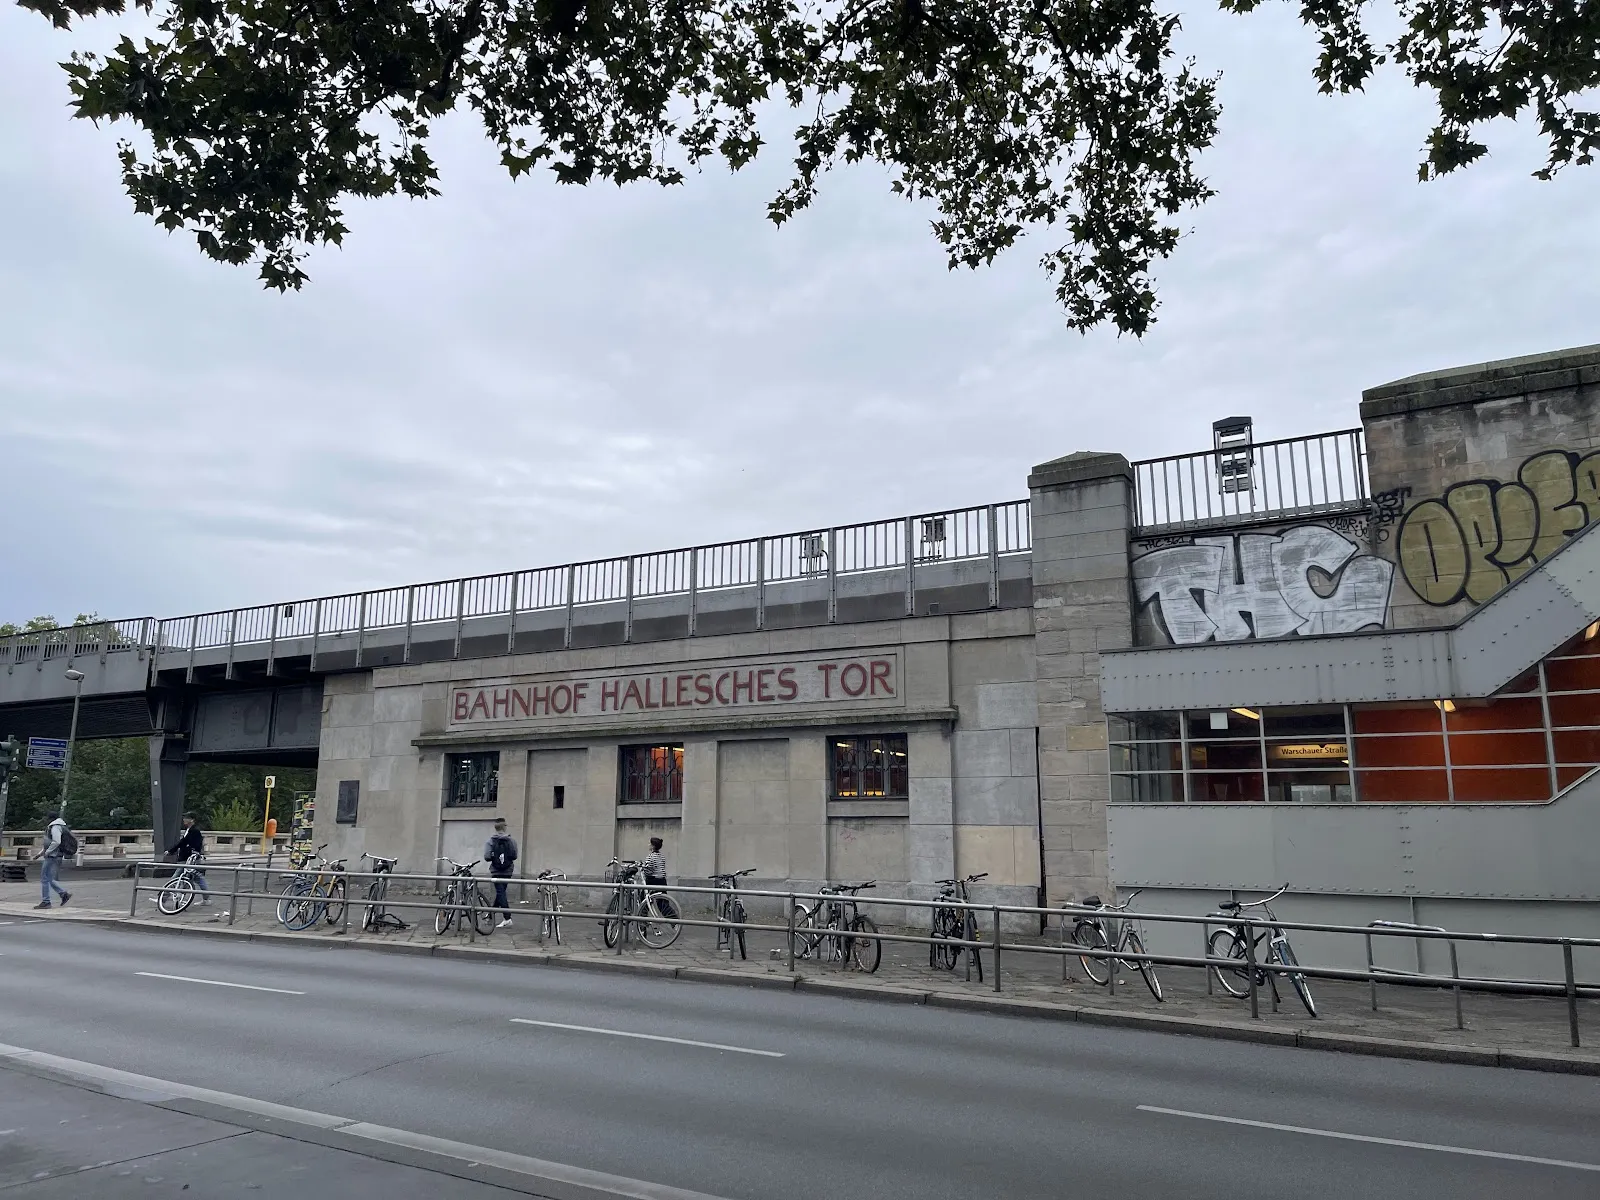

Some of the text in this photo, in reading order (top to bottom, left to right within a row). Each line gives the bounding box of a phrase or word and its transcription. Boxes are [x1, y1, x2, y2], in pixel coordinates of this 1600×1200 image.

[454, 660, 894, 721] BAHNHOF HALLESCHES TOR
[1281, 747, 1324, 756] Warschauer
